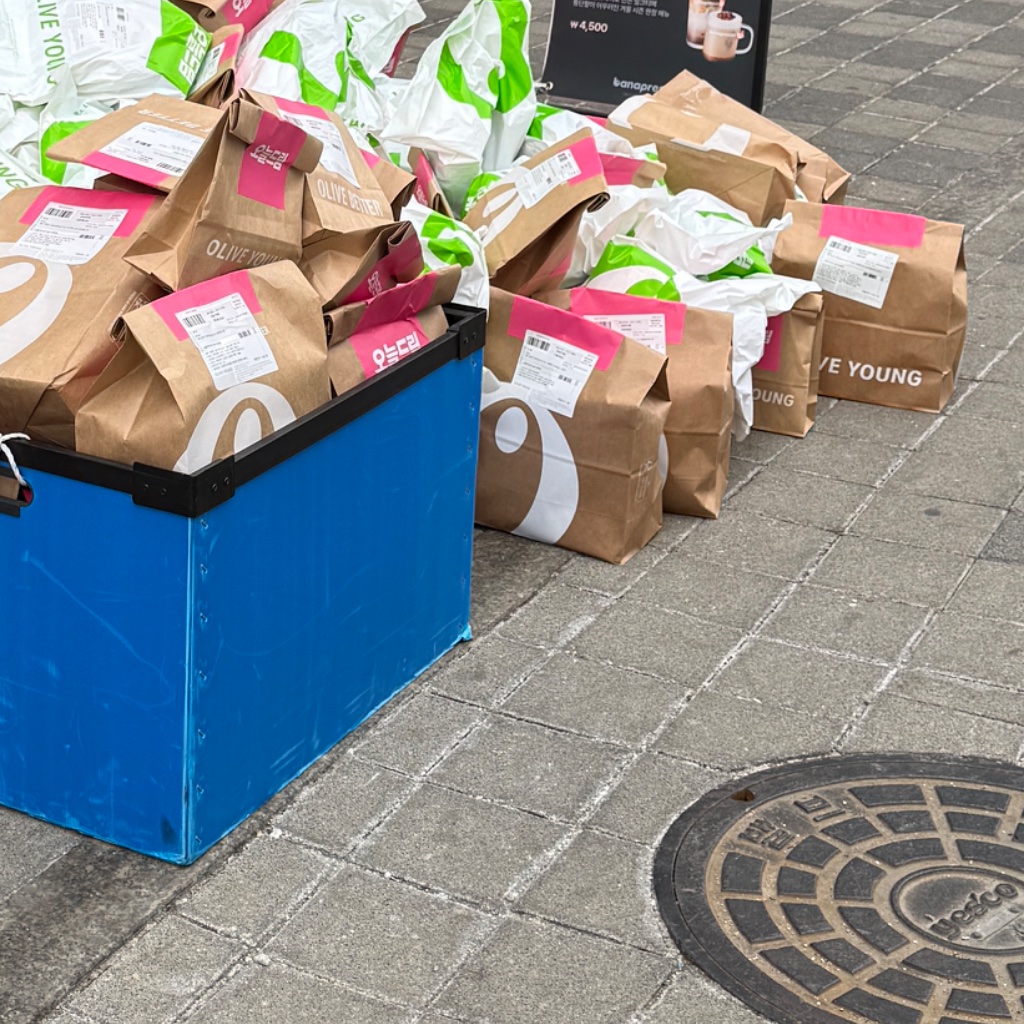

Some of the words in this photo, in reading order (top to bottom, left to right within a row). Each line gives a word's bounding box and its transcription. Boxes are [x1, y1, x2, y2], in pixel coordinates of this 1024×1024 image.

[250, 144, 289, 171] 오늘드림
[317, 178, 349, 206] OLIVE
[206, 239, 248, 264] OLIVE
[848, 360, 922, 387] YOUNG
[752, 387, 794, 407] OUNG
